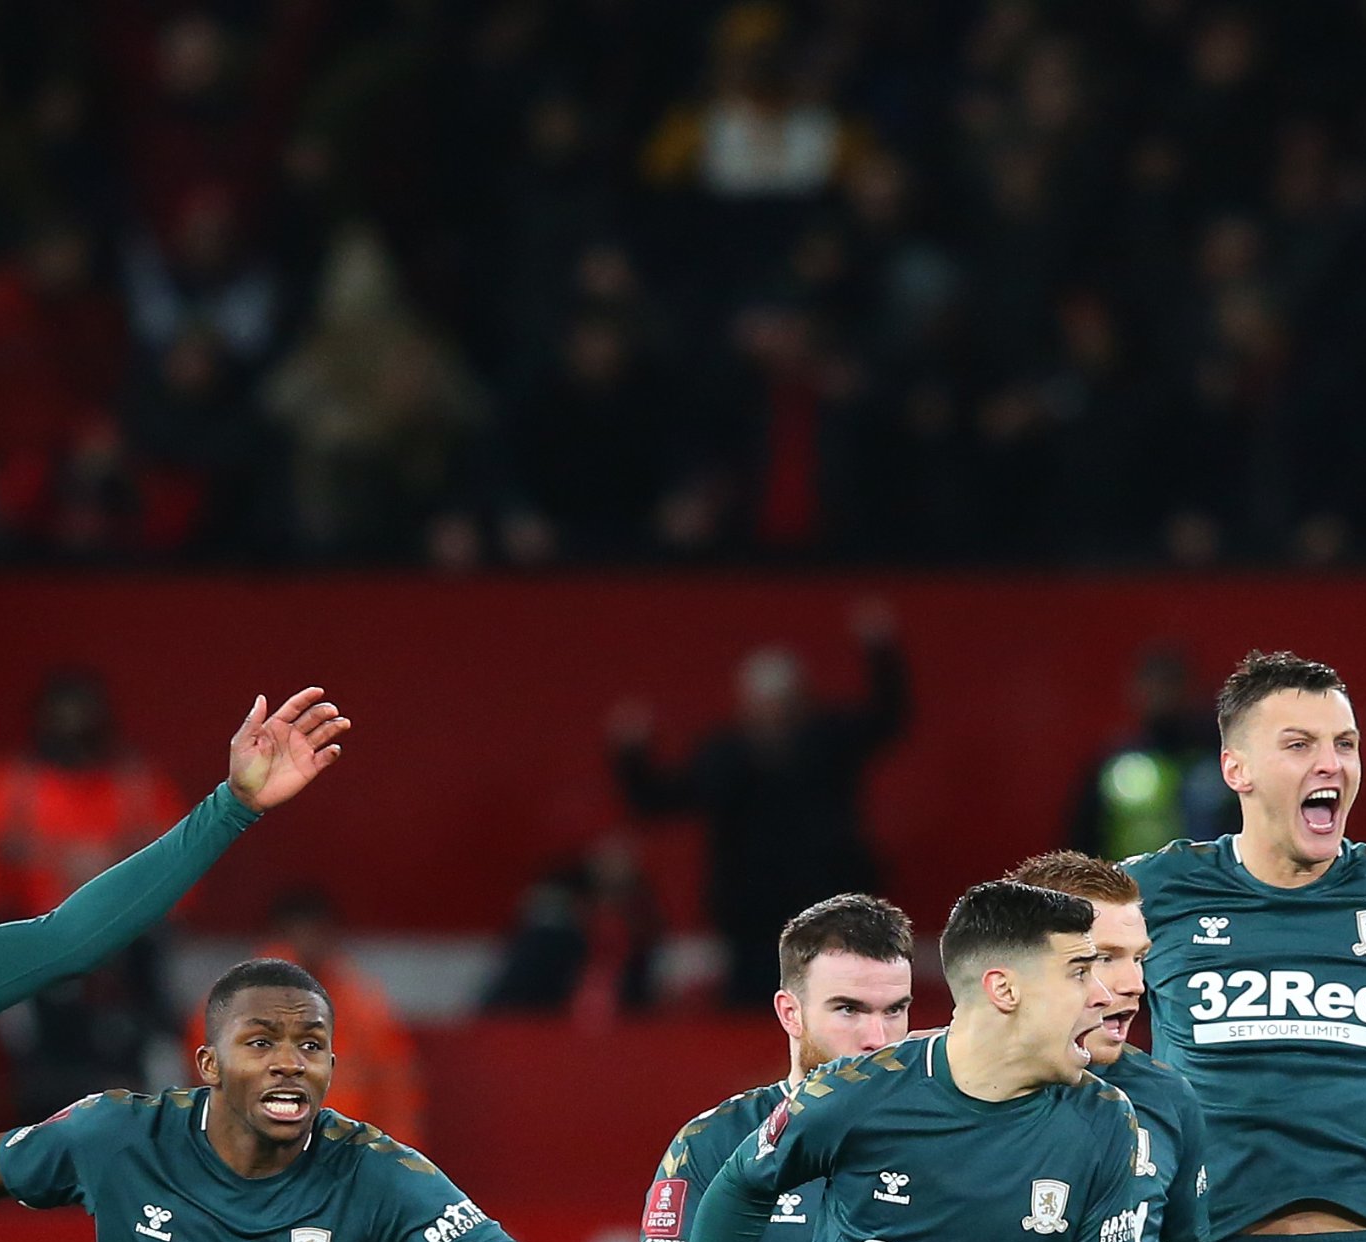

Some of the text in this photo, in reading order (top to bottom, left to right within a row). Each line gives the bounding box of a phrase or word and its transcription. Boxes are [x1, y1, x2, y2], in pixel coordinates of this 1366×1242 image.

[1228, 1024, 1351, 1039] SET YOUR LIMITS
